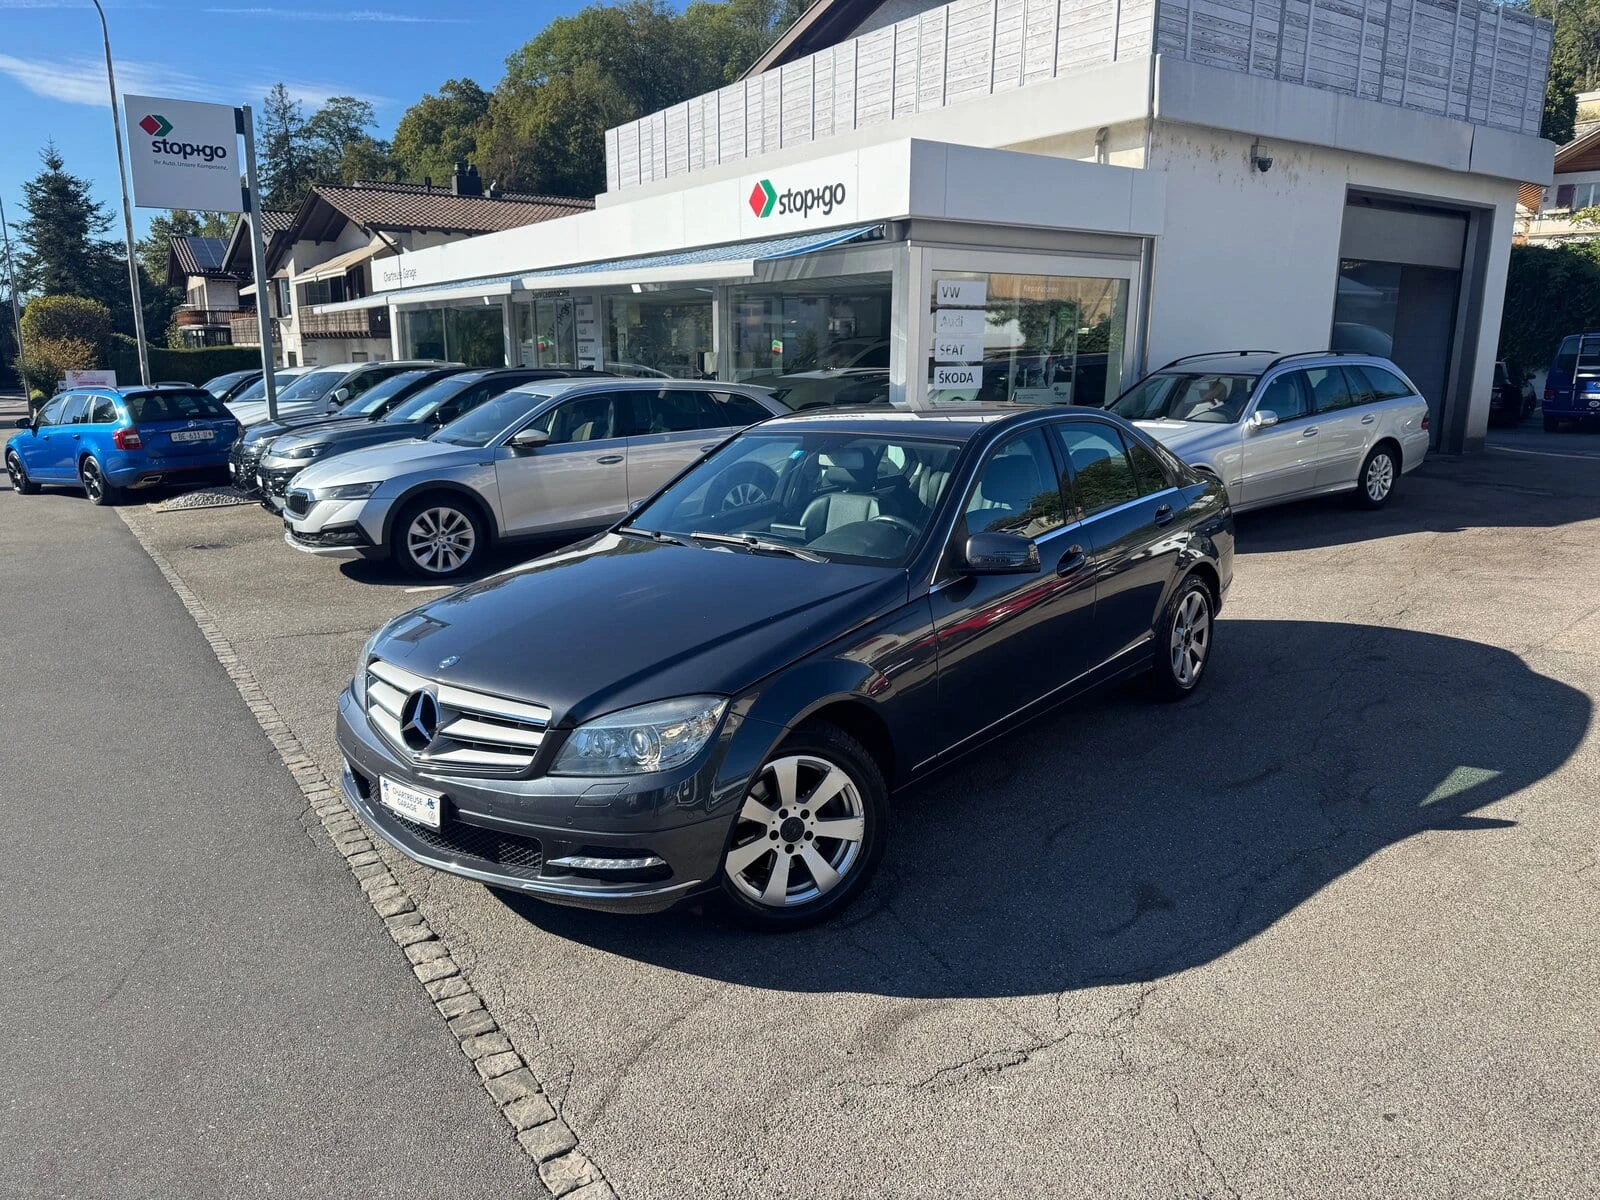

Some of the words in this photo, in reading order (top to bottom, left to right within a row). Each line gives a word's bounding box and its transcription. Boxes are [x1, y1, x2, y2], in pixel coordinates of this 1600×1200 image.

[152, 138, 226, 162] stop+go
[197, 162, 228, 170] Kompetenz.
[778, 182, 846, 219] stop+go
[942, 286, 961, 299] VW
[940, 315, 964, 328] Audi
[939, 344, 965, 356] SEAT
[938, 370, 974, 384] ŠKODA
[392, 787, 422, 805] CHARTREUSE
[397, 798, 418, 812] GARAGE
